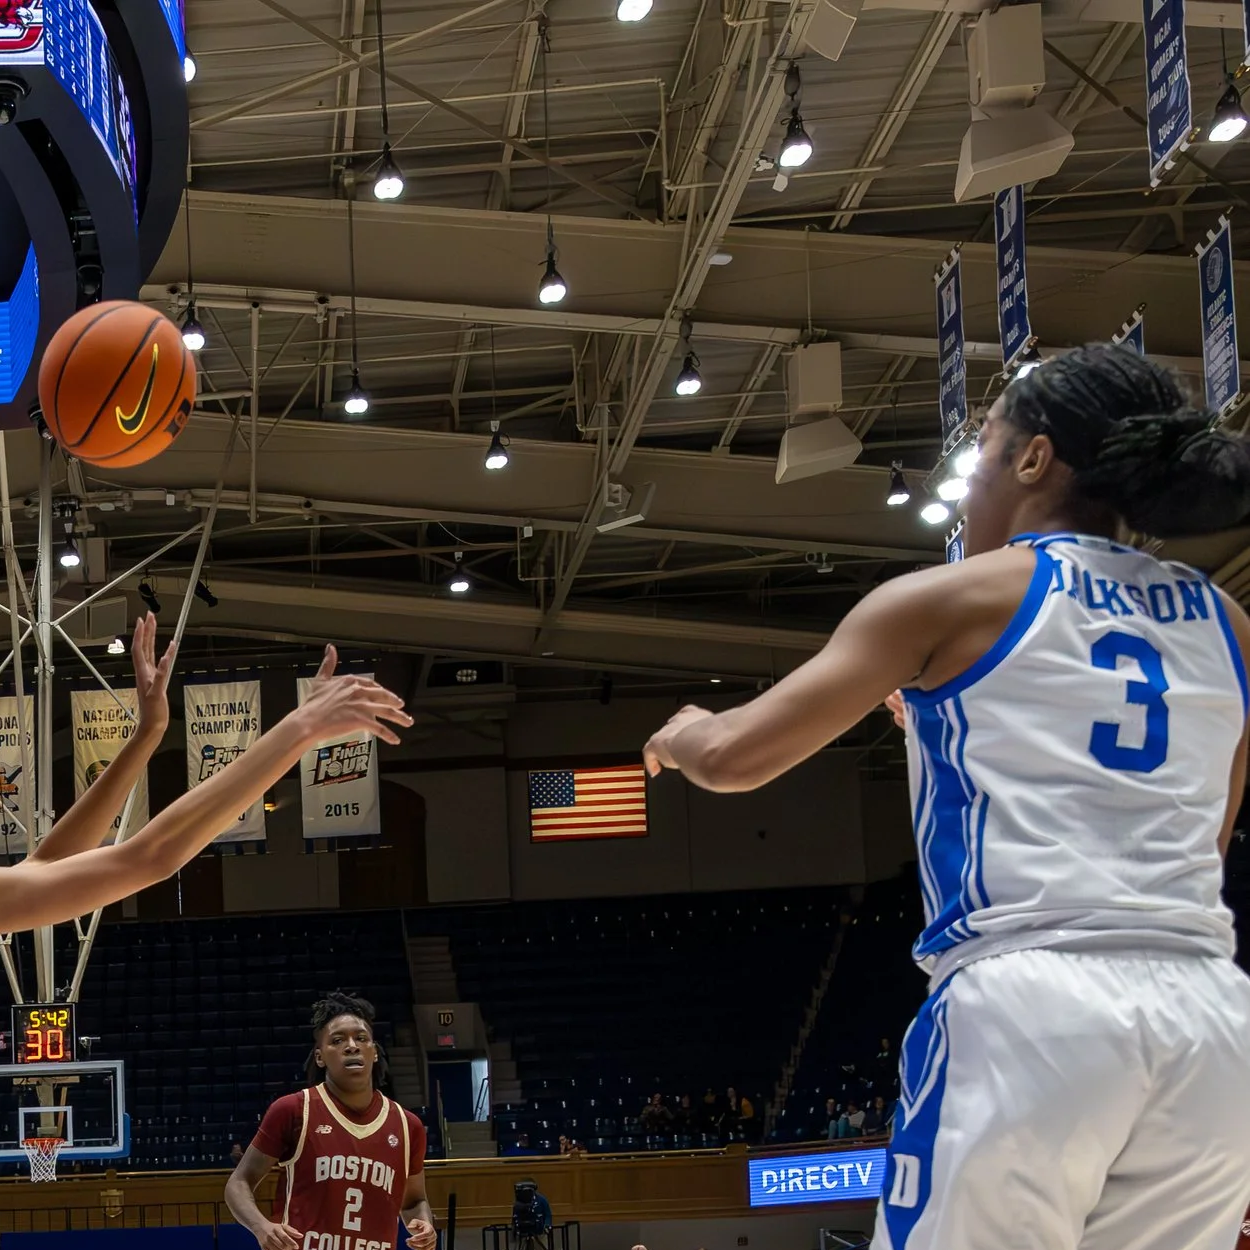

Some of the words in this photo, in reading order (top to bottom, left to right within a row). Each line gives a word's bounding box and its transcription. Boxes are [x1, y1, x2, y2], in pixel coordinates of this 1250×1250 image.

[196, 700, 251, 718] NATIONAL
[1088, 630, 1170, 774] 3
[77, 725, 137, 741] CHAMPION
[190, 717, 258, 736] CHAMPIONS
[332, 744, 371, 761] FINAL
[324, 802, 360, 818] 2015
[30, 1010, 68, 1028] 5:42
[440, 1013, 452, 1025] 10
[26, 1029, 64, 1060] 30
[315, 1154, 395, 1195] BOSTON
[762, 1161, 873, 1194] DIRECTV
[342, 1187, 364, 1232] 2
